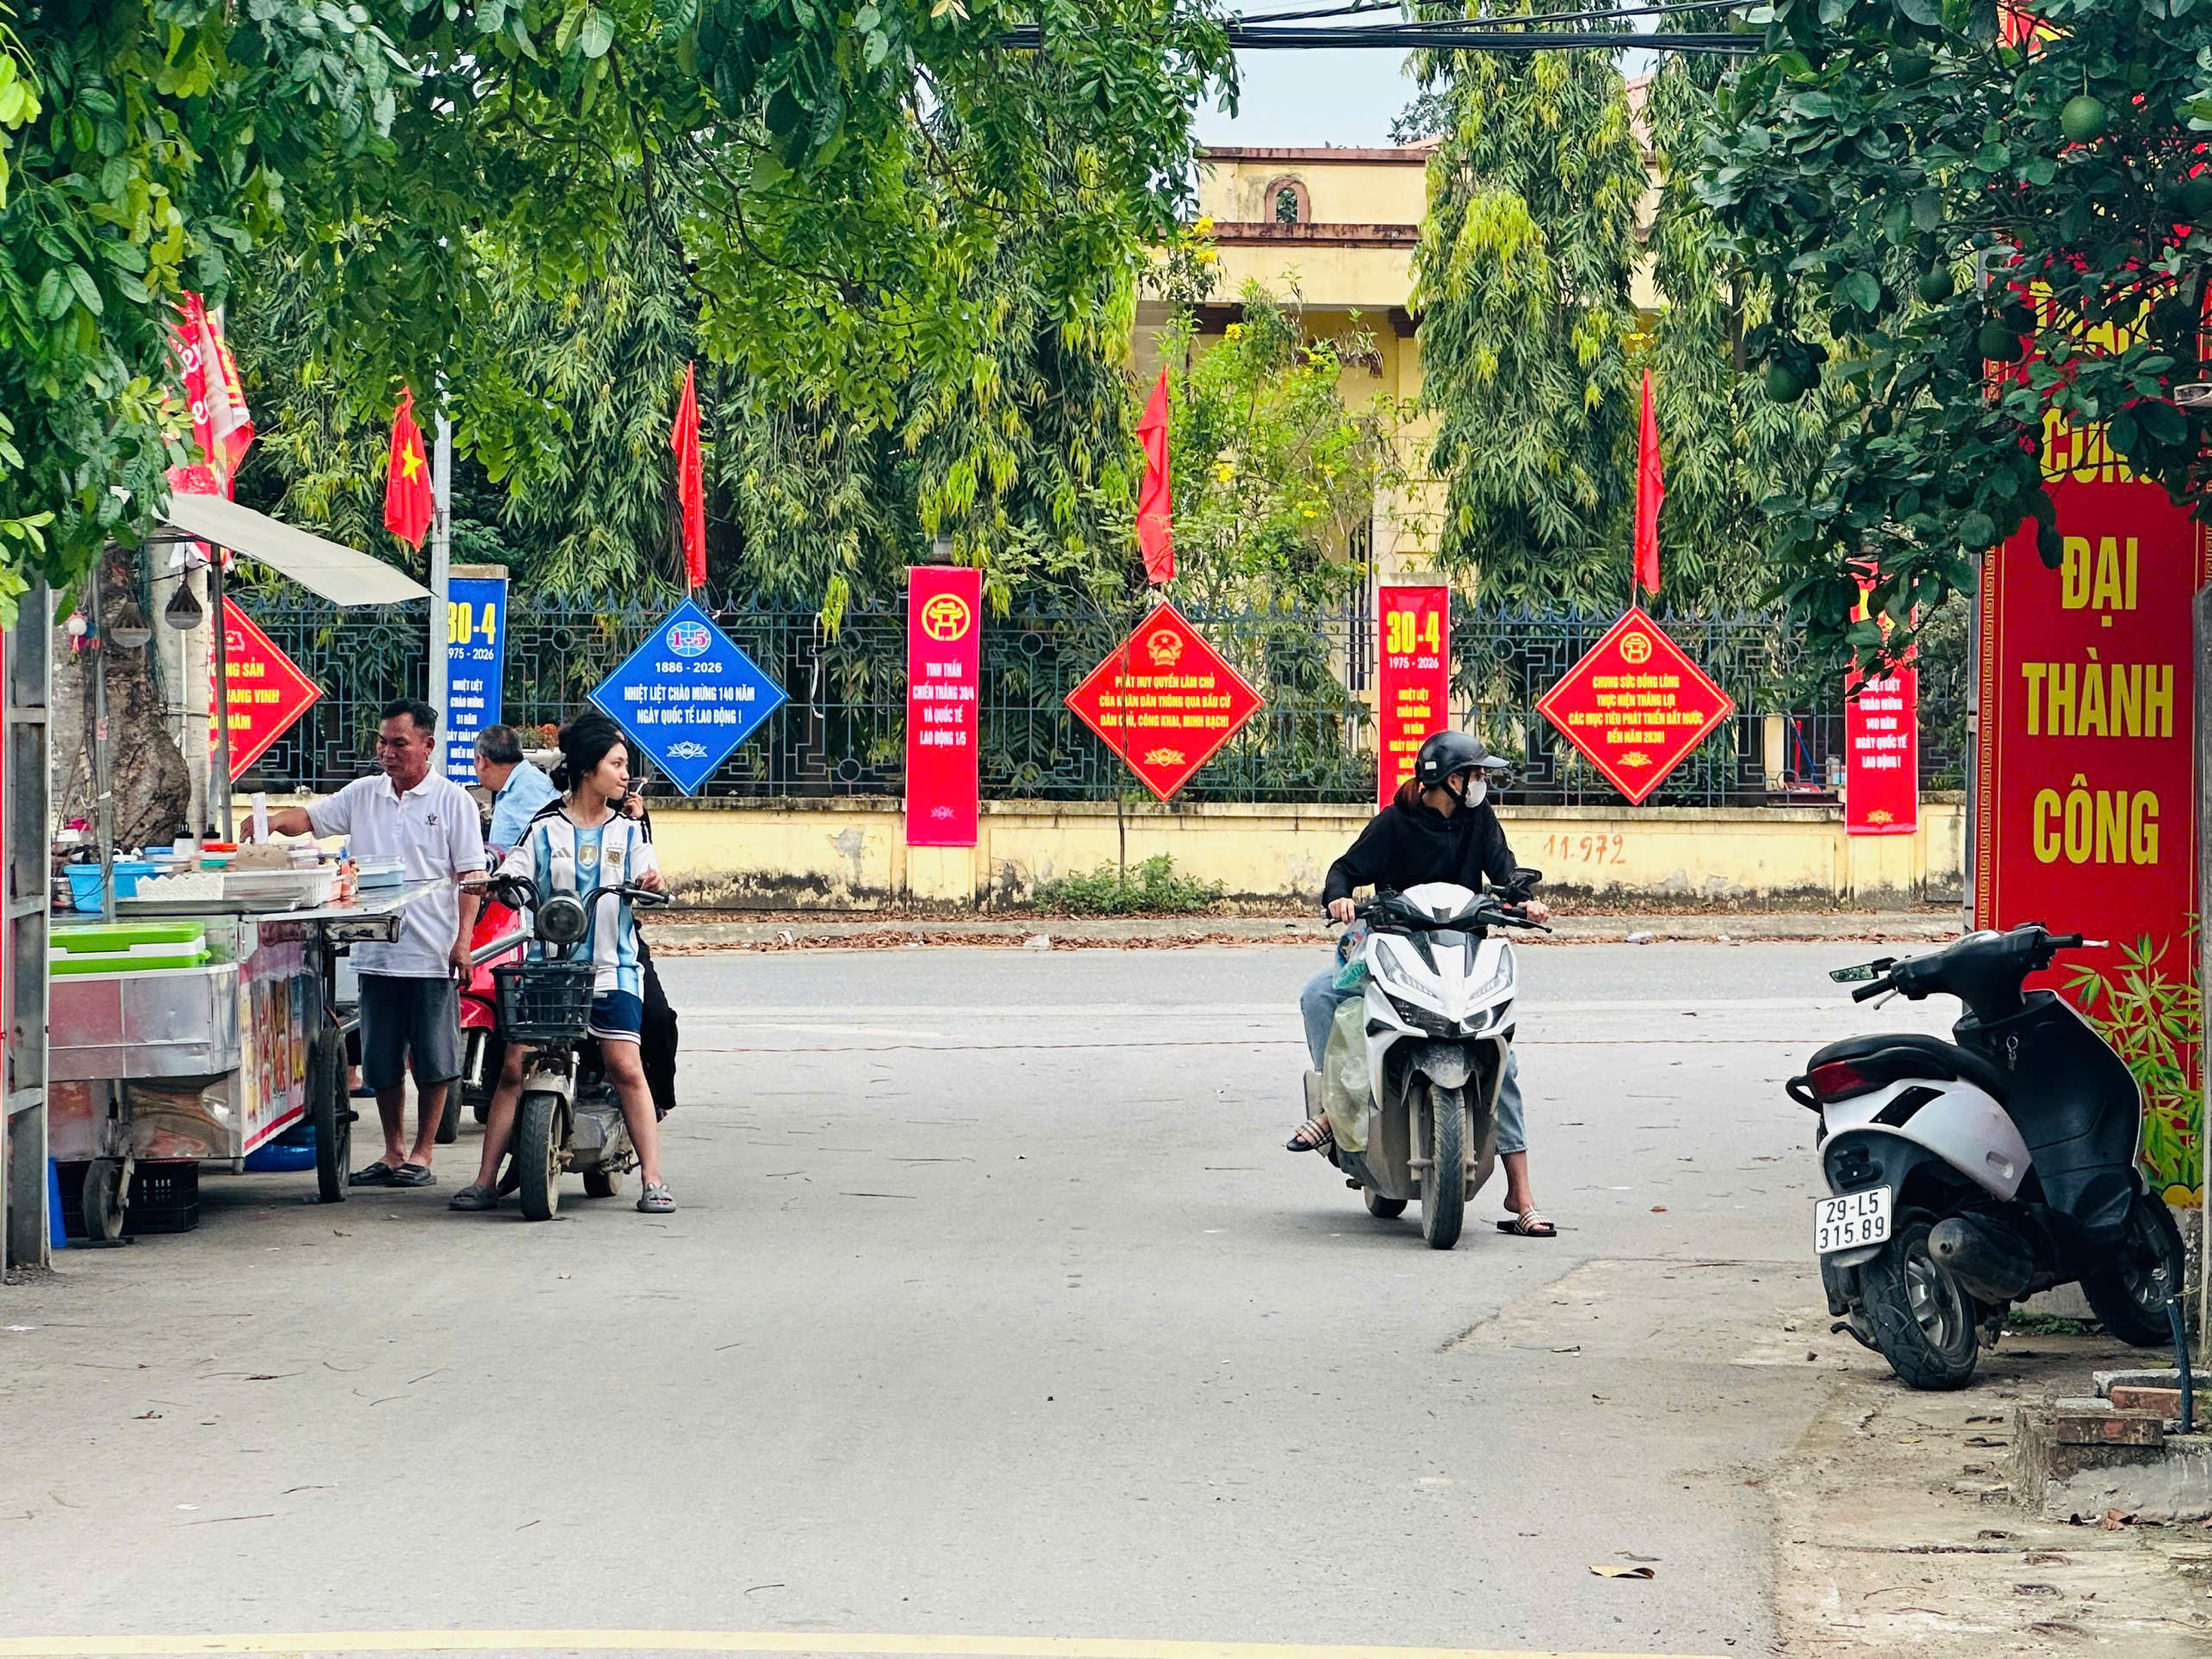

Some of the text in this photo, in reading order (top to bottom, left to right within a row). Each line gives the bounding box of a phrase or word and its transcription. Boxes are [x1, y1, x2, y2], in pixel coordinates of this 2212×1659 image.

[2060, 536, 2138, 627] ĐẠI
[673, 631, 707, 647] 1-5
[1387, 611, 1440, 654] 30-4
[447, 648, 464, 660] 975
[472, 648, 494, 661] 2026
[1389, 656, 1410, 669] 1975
[1417, 656, 1439, 669] 2026
[242, 656, 265, 678] SẢN
[655, 662, 683, 673] 1886
[693, 662, 723, 673] 2026
[254, 688, 280, 704] VINH
[624, 682, 755, 704] NHIỆT LIỆT CHÀO MỪNG 140 NĂM
[2022, 647, 2174, 738] THÀNH
[227, 713, 252, 730] NĂM
[637, 706, 659, 724] NGÀY
[661, 705, 683, 725] QUỐC
[685, 705, 696, 724] TẾ
[696, 709, 712, 724] LAO
[713, 706, 736, 727] ĐỘNG
[447, 729, 457, 742] GÀY
[2033, 773, 2159, 865] CÔNG
[1825, 1191, 1880, 1224] 29-L5
[1819, 1216, 1885, 1250] 315.89
